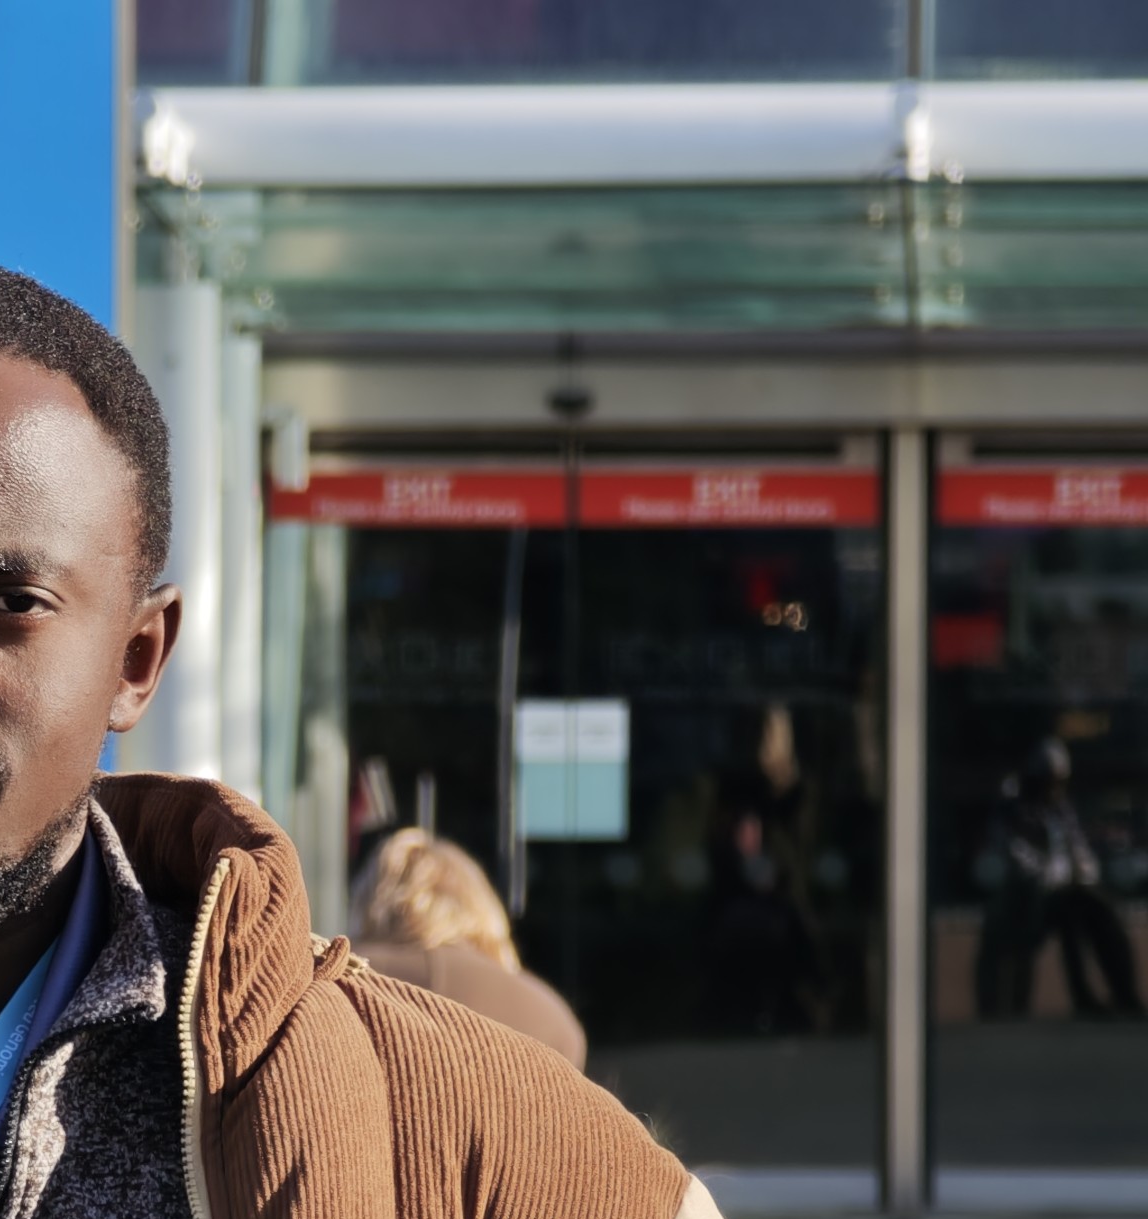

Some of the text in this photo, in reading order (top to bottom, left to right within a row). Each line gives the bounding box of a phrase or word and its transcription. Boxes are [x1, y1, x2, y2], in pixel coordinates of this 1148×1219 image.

[382, 477, 454, 505] EXIT
[692, 477, 761, 505] EXIT
[1055, 476, 1122, 505] EXIT
